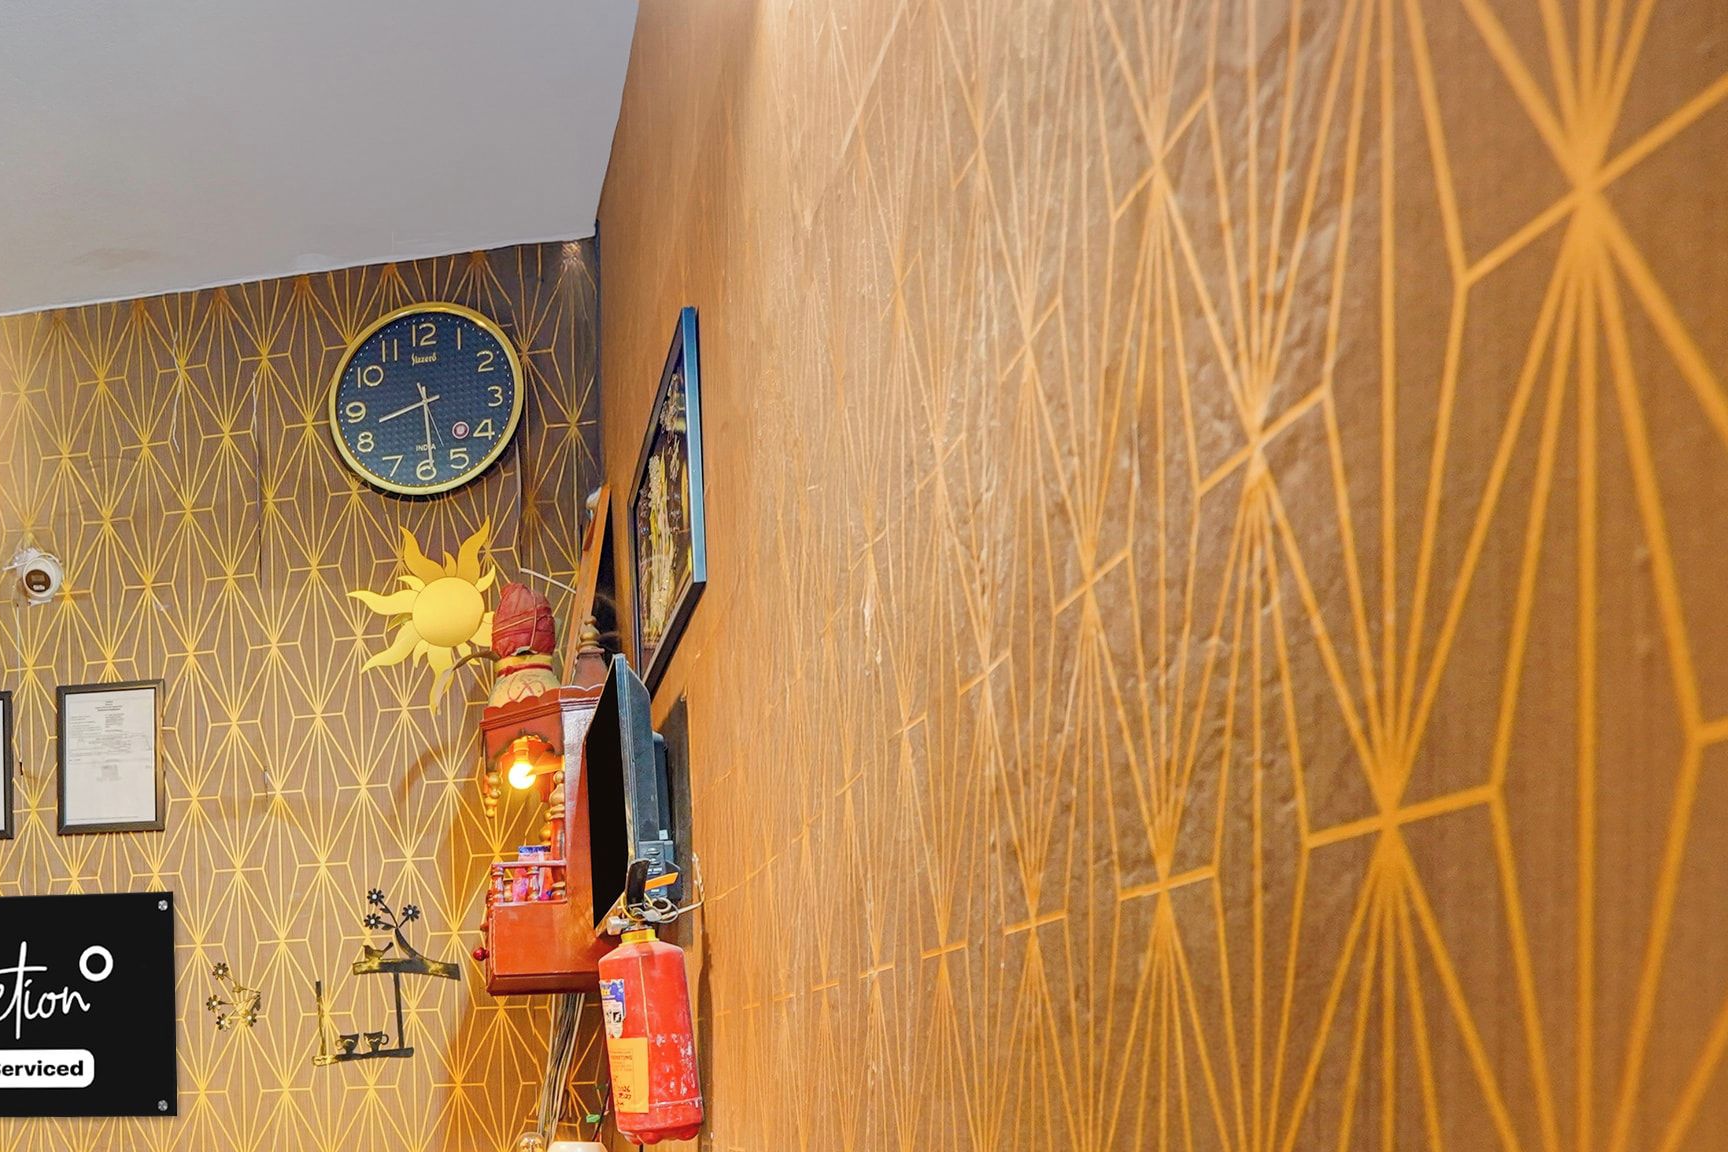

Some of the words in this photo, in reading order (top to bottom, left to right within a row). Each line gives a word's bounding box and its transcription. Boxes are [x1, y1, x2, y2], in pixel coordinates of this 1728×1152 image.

[412, 322, 437, 347] 12
[457, 327, 461, 350] 1
[381, 338, 398, 362] 11
[476, 350, 495, 372] 2
[356, 365, 384, 388] 10
[487, 385, 504, 408] 3
[345, 401, 366, 424] 9
[473, 418, 496, 440] 4
[357, 430, 374, 452] 8
[382, 454, 404, 477] 7
[416, 459, 437, 481] 6
[449, 448, 470, 470] 5
